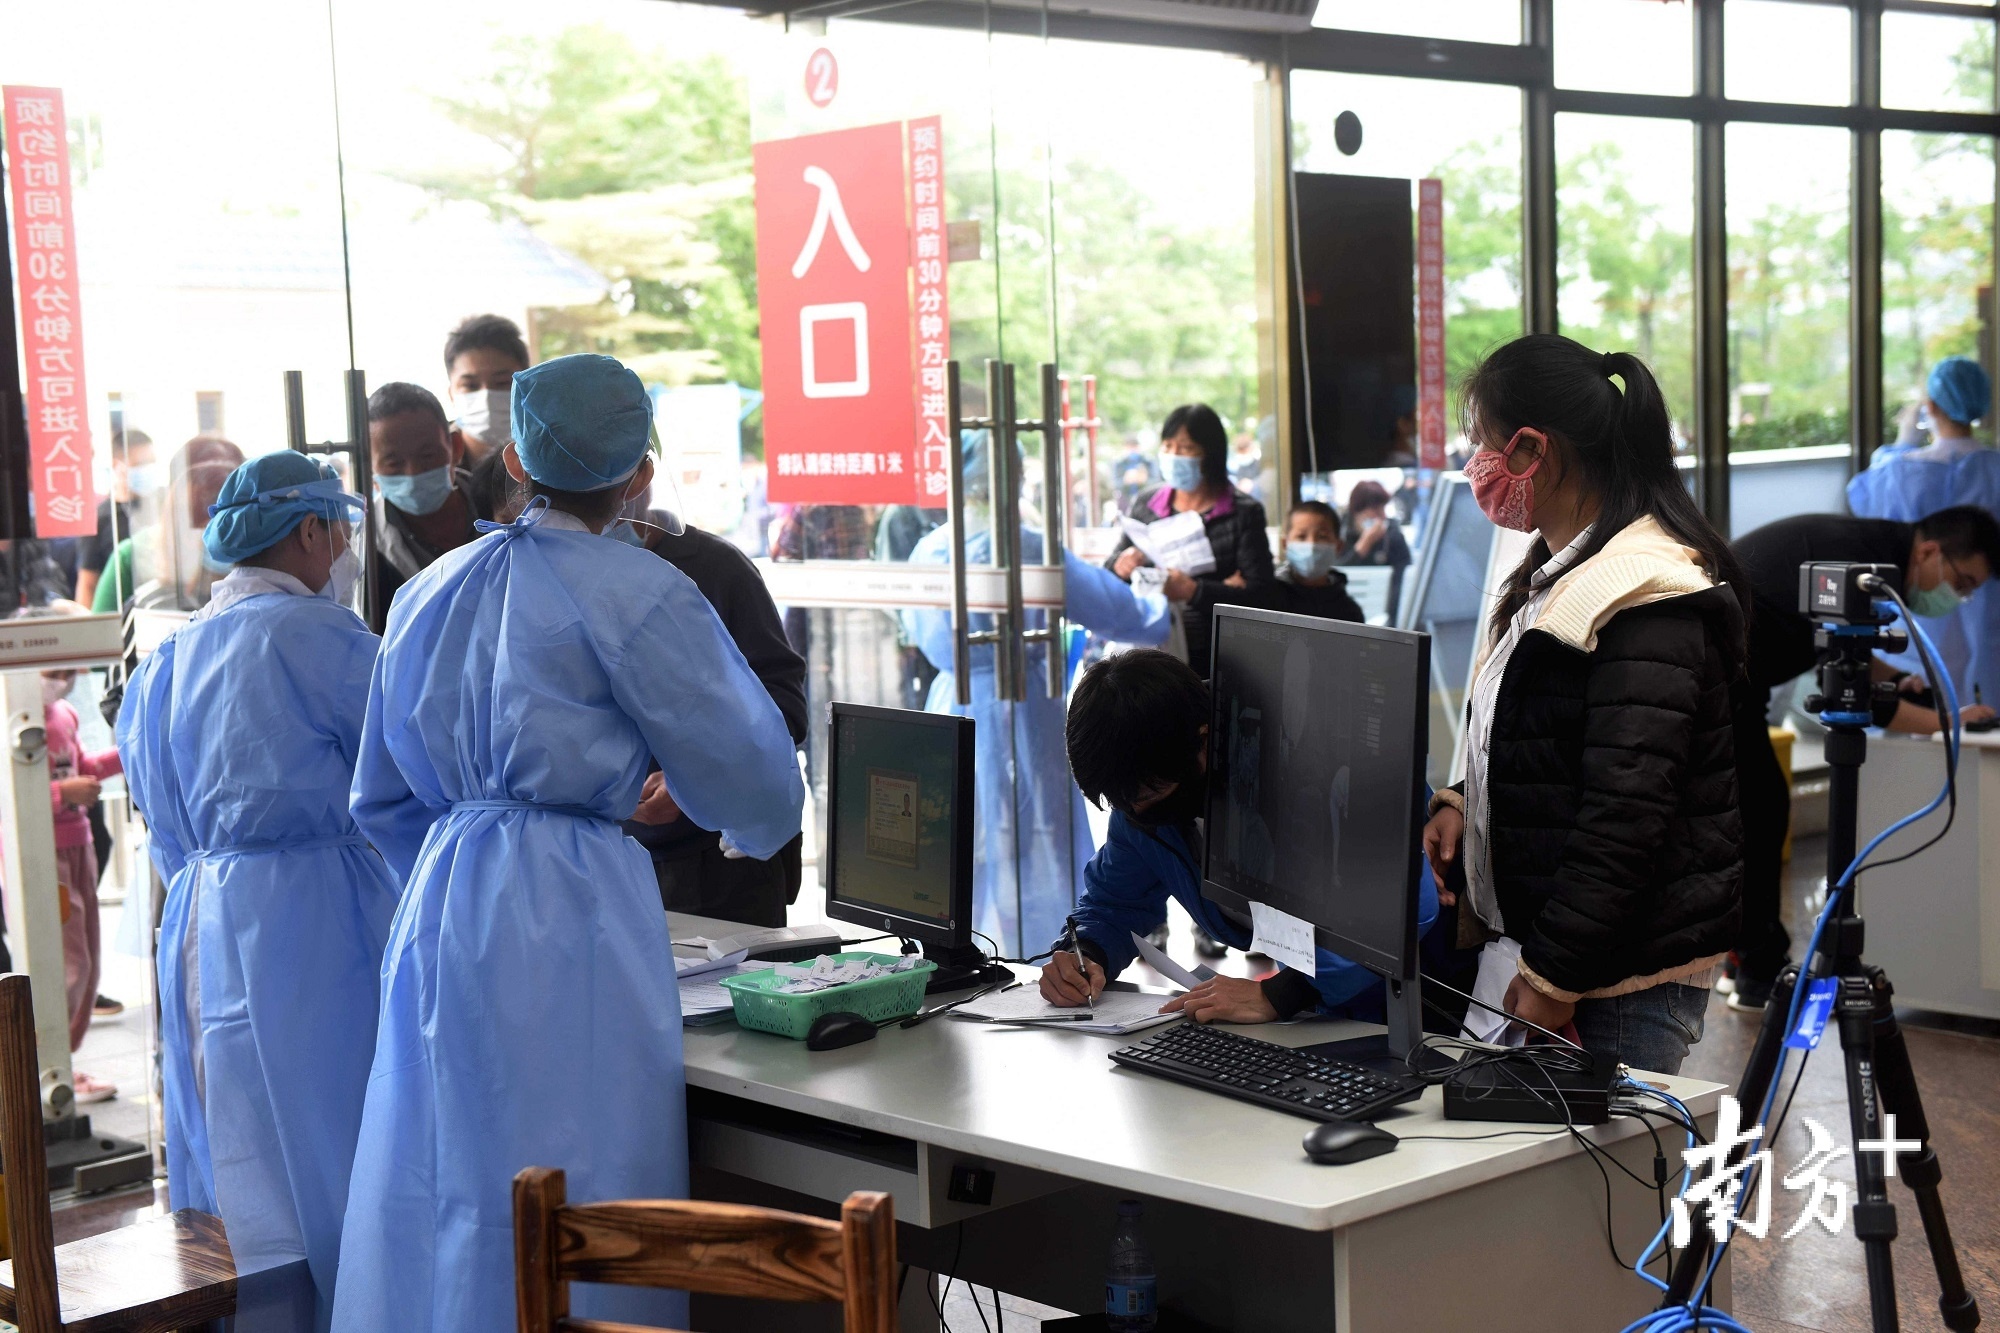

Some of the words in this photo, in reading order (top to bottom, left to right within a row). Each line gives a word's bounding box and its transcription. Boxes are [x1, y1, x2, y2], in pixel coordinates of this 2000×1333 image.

[812, 53, 834, 101] 2
[791, 165, 871, 399] 入口
[912, 125, 948, 496] 预约时间前30分钟方可进入门诊
